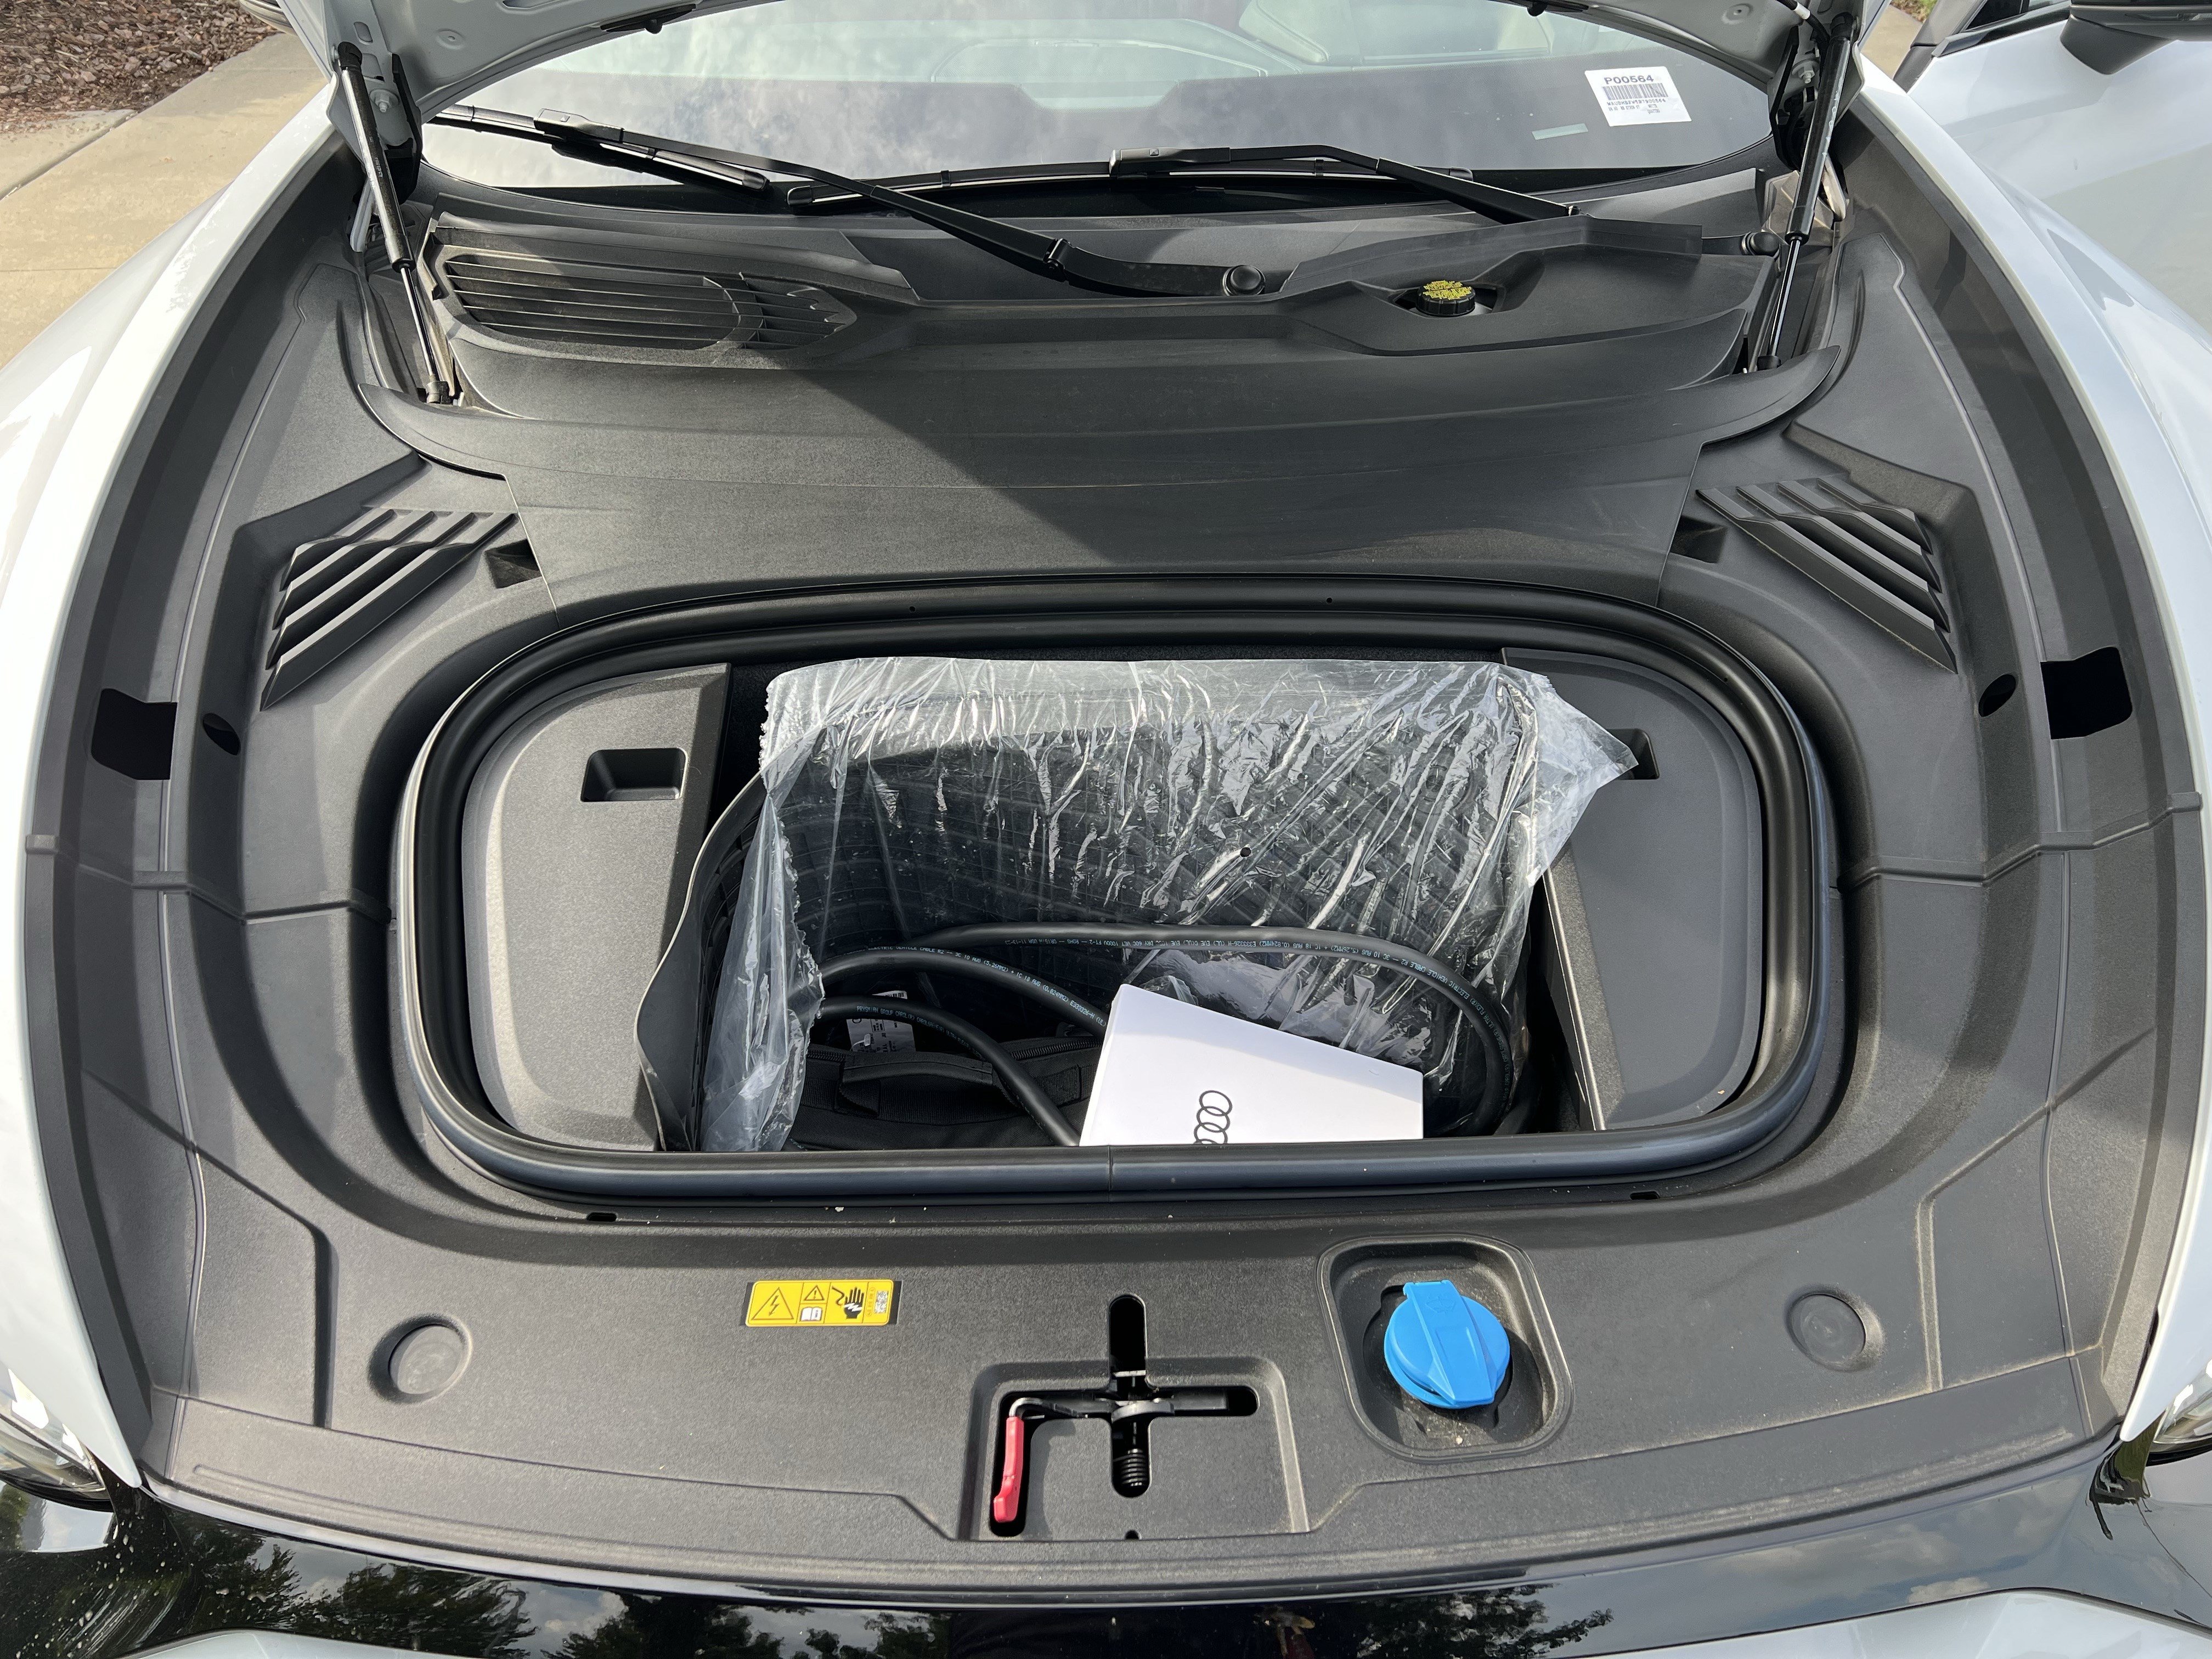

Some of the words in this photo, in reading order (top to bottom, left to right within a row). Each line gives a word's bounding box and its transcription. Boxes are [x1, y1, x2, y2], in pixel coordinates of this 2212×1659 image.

[1604, 75, 1654, 84] P00564
[1330, 944, 1359, 953] (5.26MM2)
[1362, 948, 1372, 956] AWG
[1410, 960, 1426, 973] CABLE
[1427, 968, 1448, 984] VEHICLE
[983, 960, 1009, 973] (5.26MM2)
[1031, 979, 1041, 988] AWG
[1042, 984, 1069, 1002] (0.824MM2)
[1070, 1000, 1095, 1019] E333326-H
[1096, 1017, 1107, 1027] (UL)
[1448, 980, 1470, 998] ELECTRIC
[1470, 995, 1486, 1015] FLEX(R)
